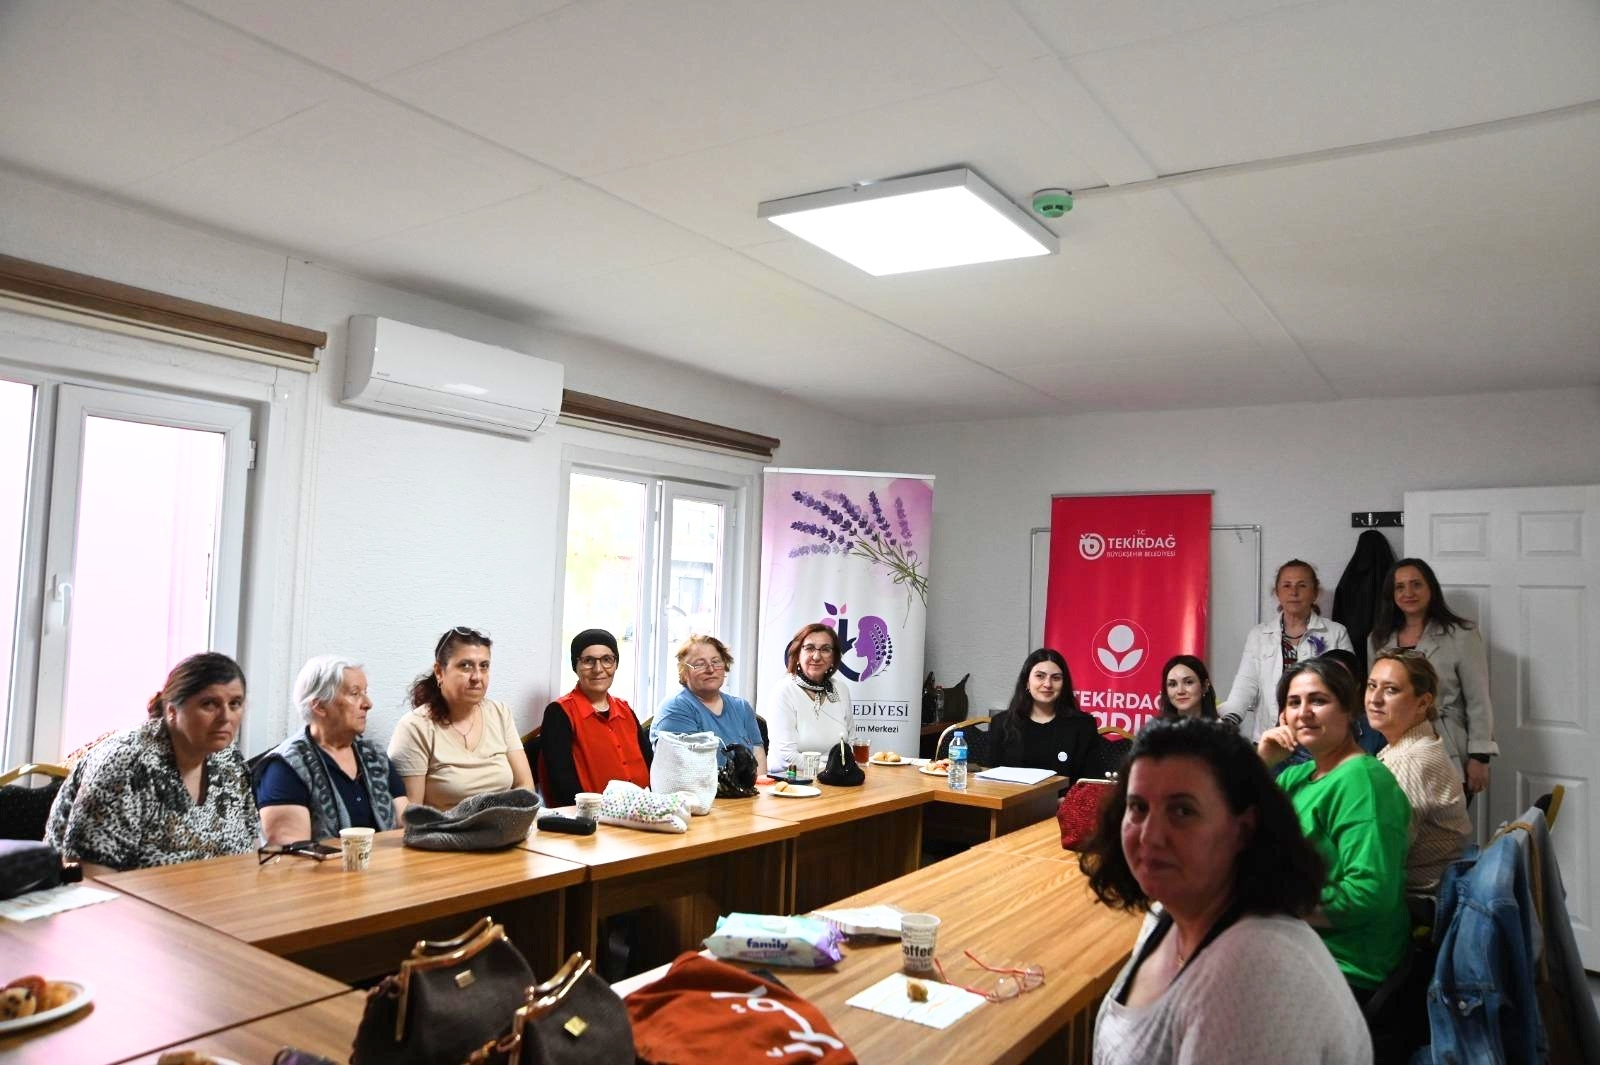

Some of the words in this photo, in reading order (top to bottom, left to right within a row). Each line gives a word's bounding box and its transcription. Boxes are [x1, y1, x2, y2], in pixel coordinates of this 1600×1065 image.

[1107, 534, 1176, 548] TEKİRDAĞ
[853, 702, 908, 717] EDİYESİ
[868, 724, 898, 733] Merkezi
[746, 937, 789, 951] family
